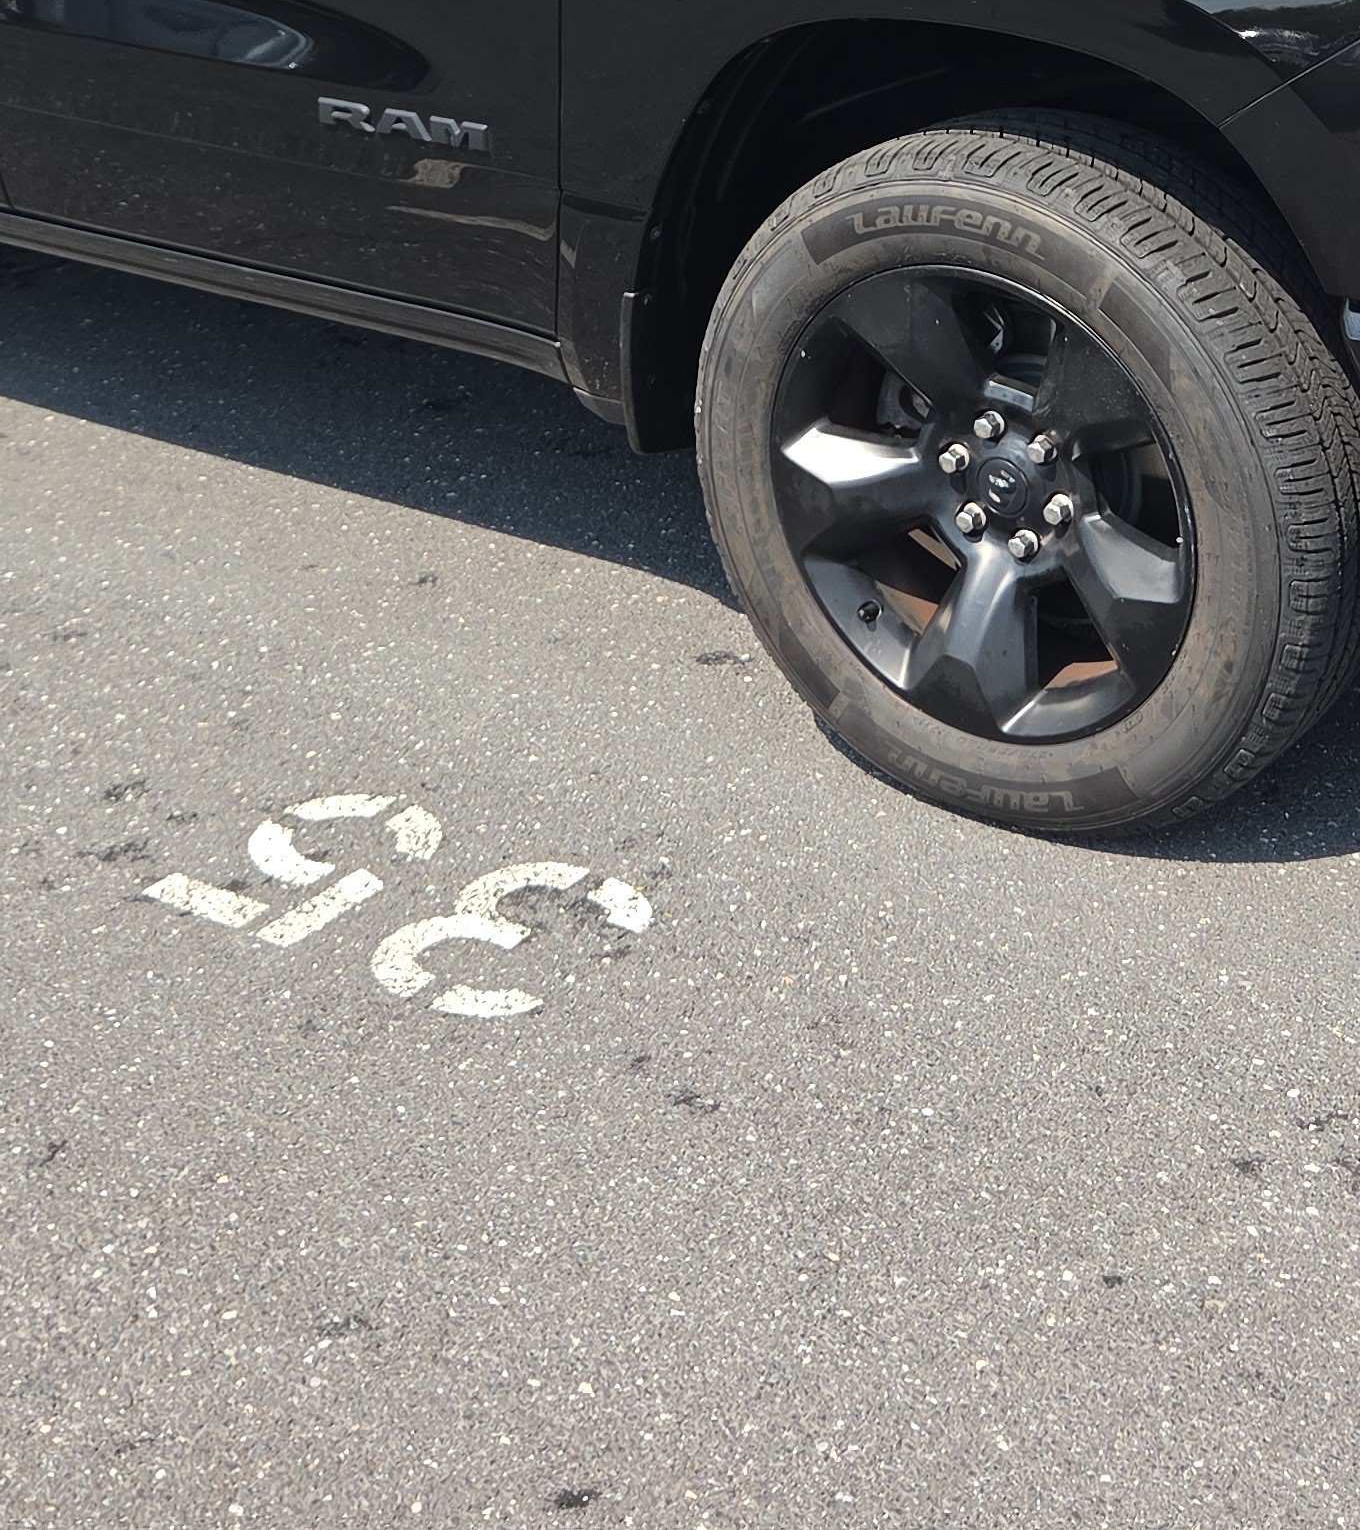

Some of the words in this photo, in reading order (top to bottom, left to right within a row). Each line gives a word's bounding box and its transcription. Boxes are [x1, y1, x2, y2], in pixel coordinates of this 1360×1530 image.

[317, 96, 489, 152] RAM
[846, 205, 1046, 261] Laufenn
[141, 793, 653, 1018] 35
